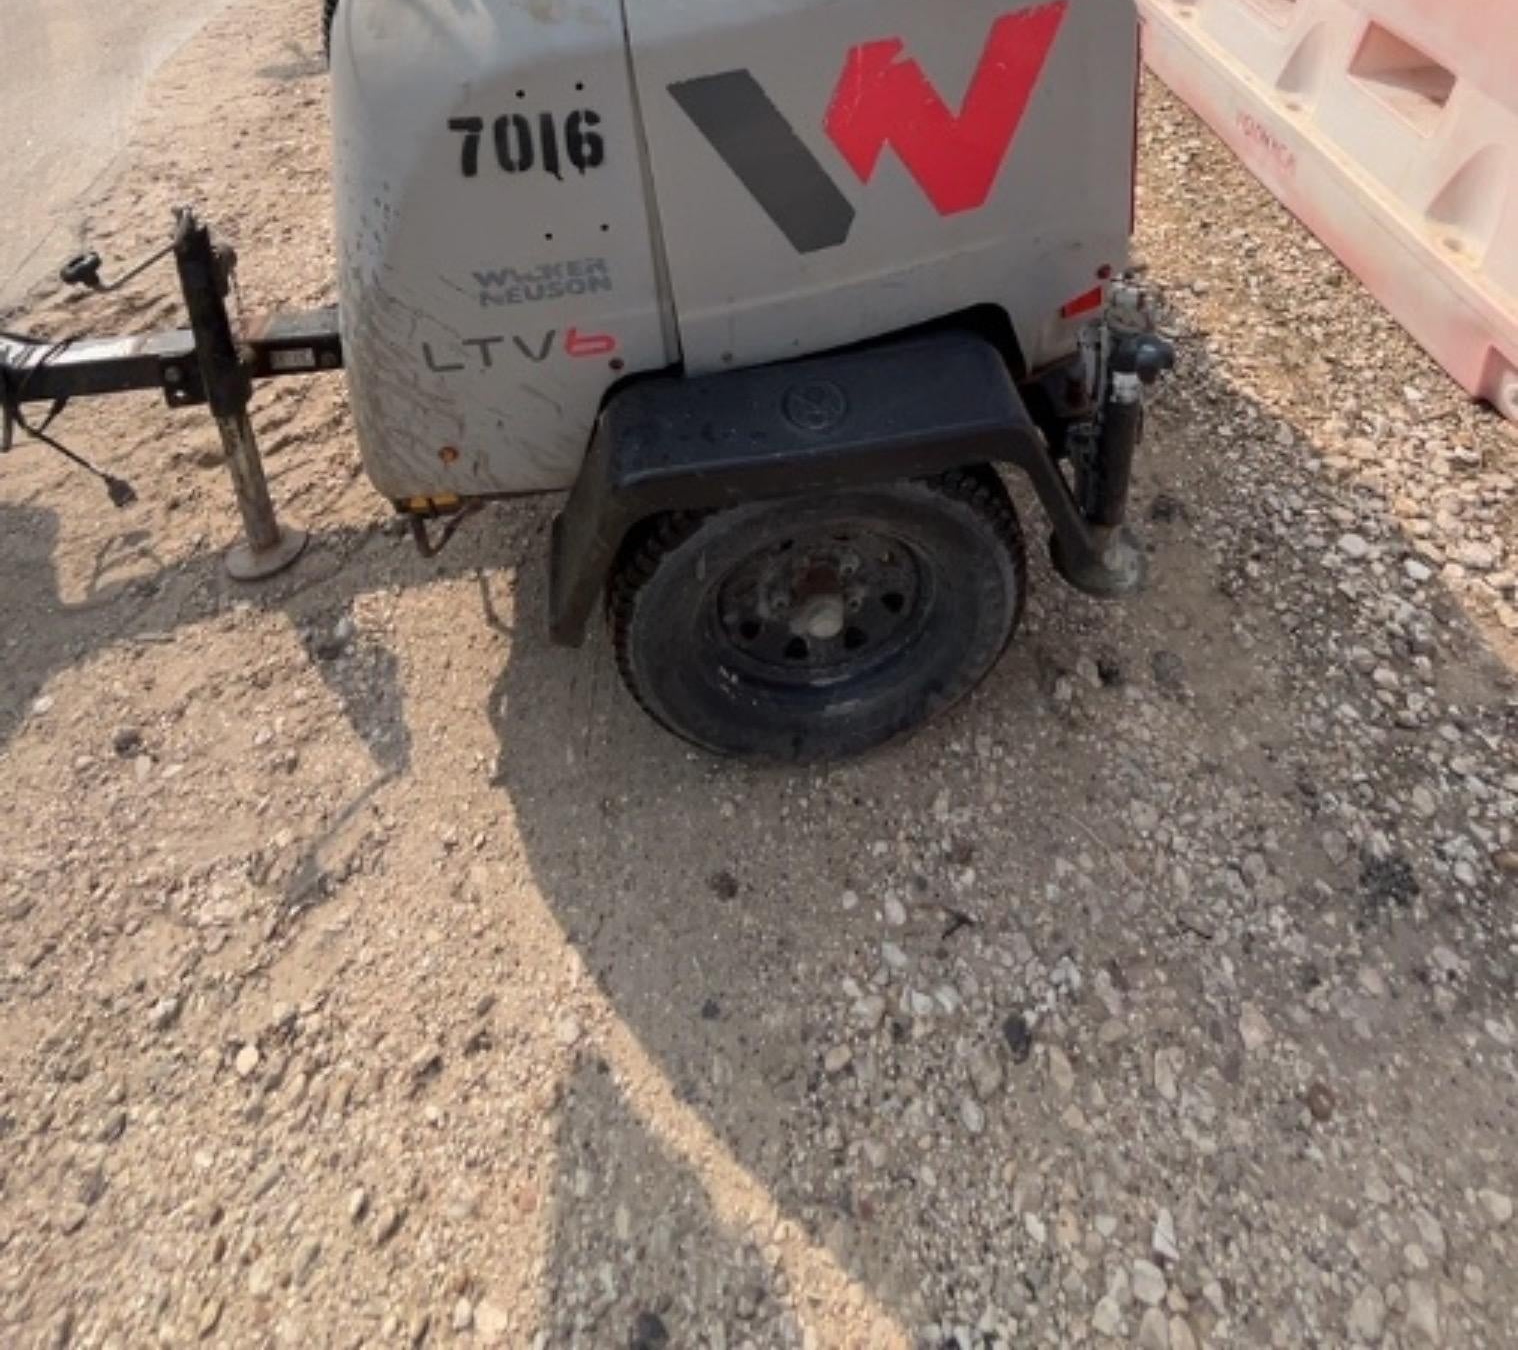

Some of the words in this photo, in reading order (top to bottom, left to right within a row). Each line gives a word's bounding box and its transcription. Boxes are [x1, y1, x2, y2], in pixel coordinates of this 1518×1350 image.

[448, 108, 605, 180] 7016
[479, 274, 612, 307] NEUSON
[422, 327, 616, 372] LTV6
